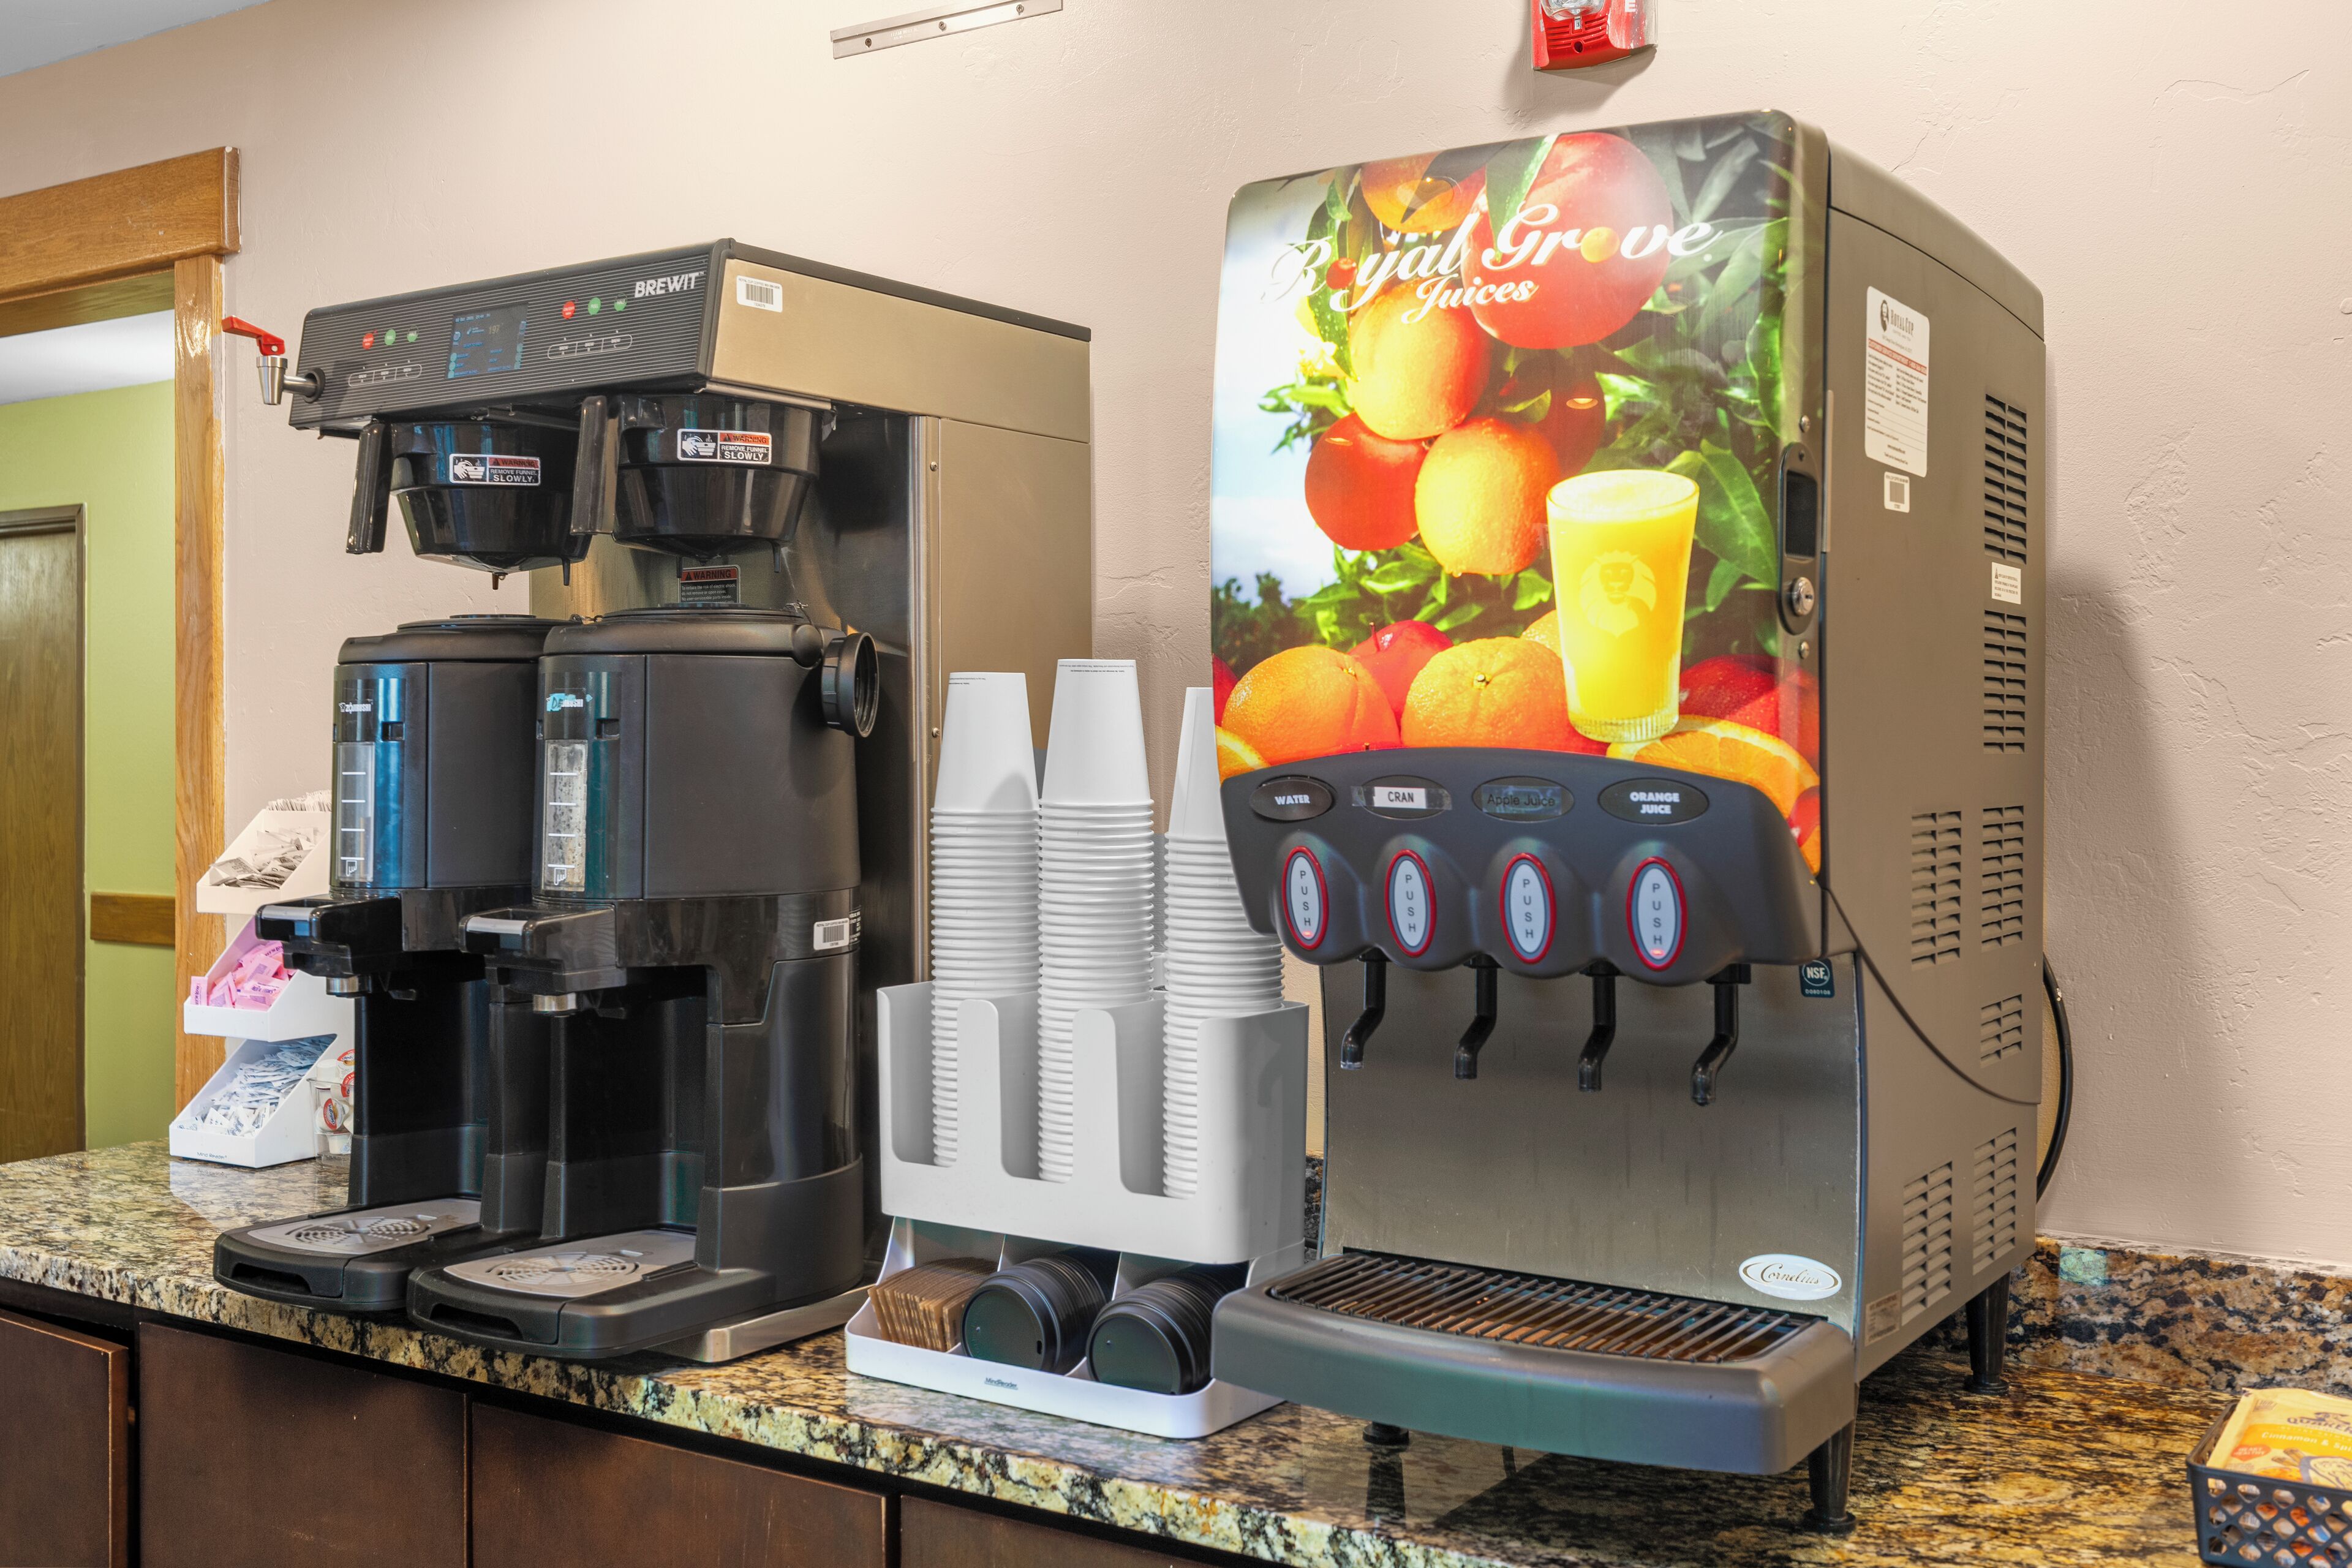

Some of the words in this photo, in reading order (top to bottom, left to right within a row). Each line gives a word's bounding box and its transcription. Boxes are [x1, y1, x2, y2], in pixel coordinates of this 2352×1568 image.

[635, 272, 699, 298] BREWIT
[1401, 274, 1539, 323] Juices
[733, 435, 767, 443] WARNING
[724, 451, 764, 461] SLOWLY
[693, 570, 731, 579] WARNING
[1274, 793, 1311, 807] WATER
[1387, 791, 1415, 804] CRAN
[1487, 794, 1520, 809] Apple
[1524, 795, 1556, 807] Juice
[1629, 791, 1680, 804] ORANGE
[1640, 803, 1672, 816] JUICE
[1299, 869, 1312, 927] PUSH
[1404, 873, 1417, 935] PUSH
[1522, 878, 1534, 940] PUSH
[1651, 882, 1664, 945] PUSH
[1806, 967, 1825, 979] NSF
[1760, 1262, 1820, 1284] Cornelius
[2261, 1431, 2318, 1444] Cinnamon
[2333, 1442, 2352, 1452] Spi
